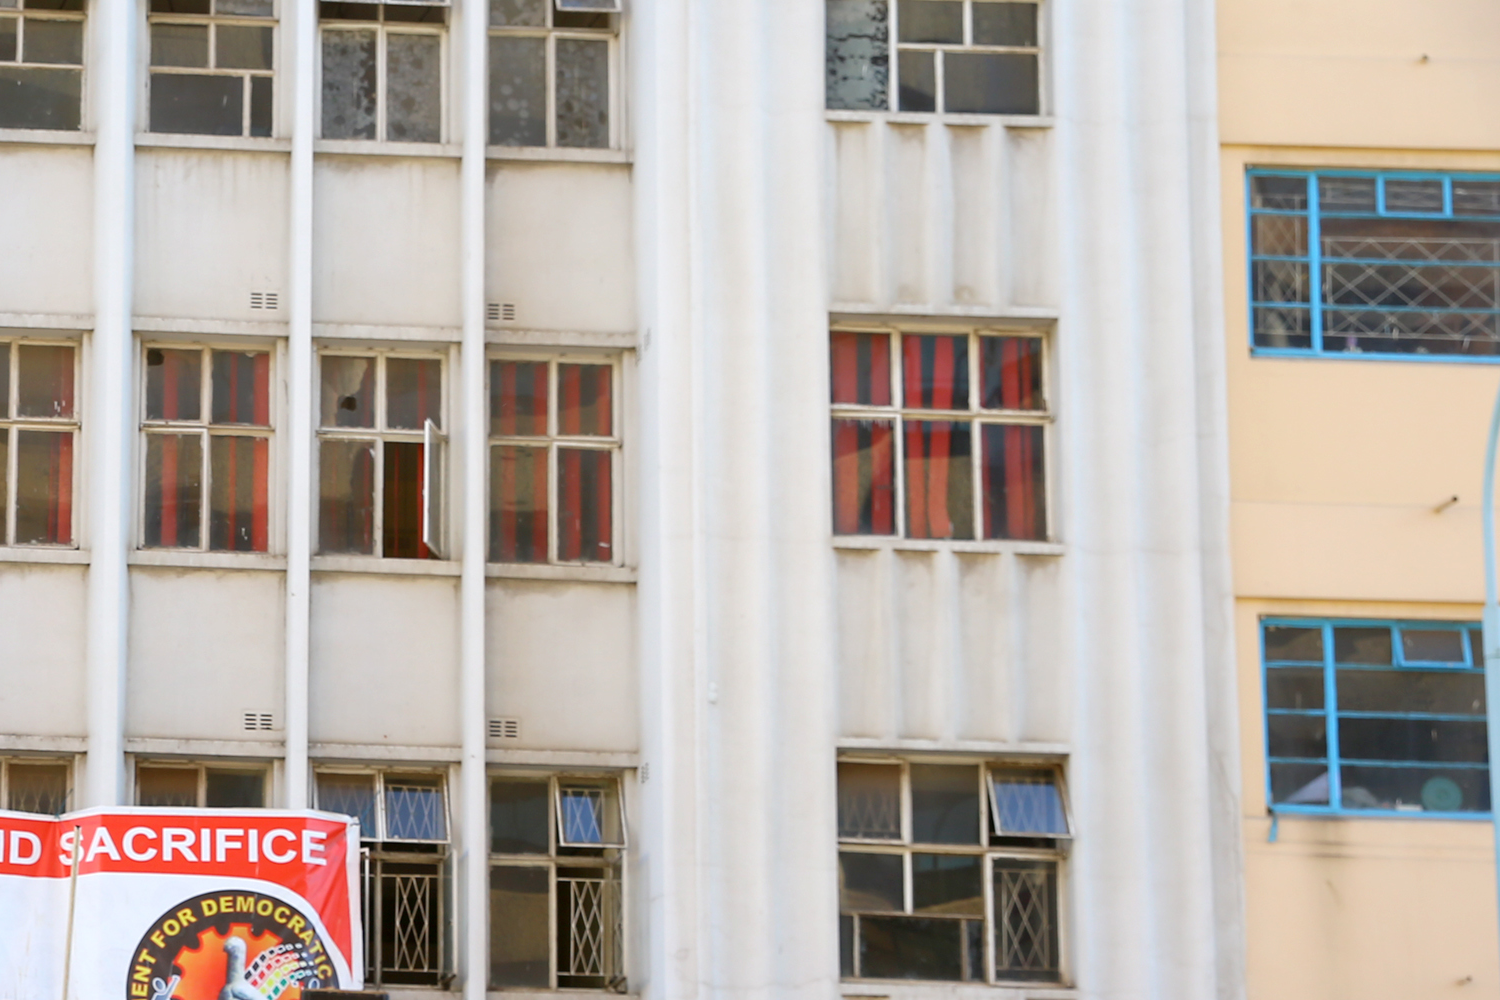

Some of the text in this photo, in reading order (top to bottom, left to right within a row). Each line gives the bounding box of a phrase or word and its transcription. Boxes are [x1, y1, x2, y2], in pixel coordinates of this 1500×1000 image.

[58, 826, 328, 867] SACRIFICE
[150, 907, 197, 949] FOR
[200, 896, 333, 980] DEMOCRATIC
